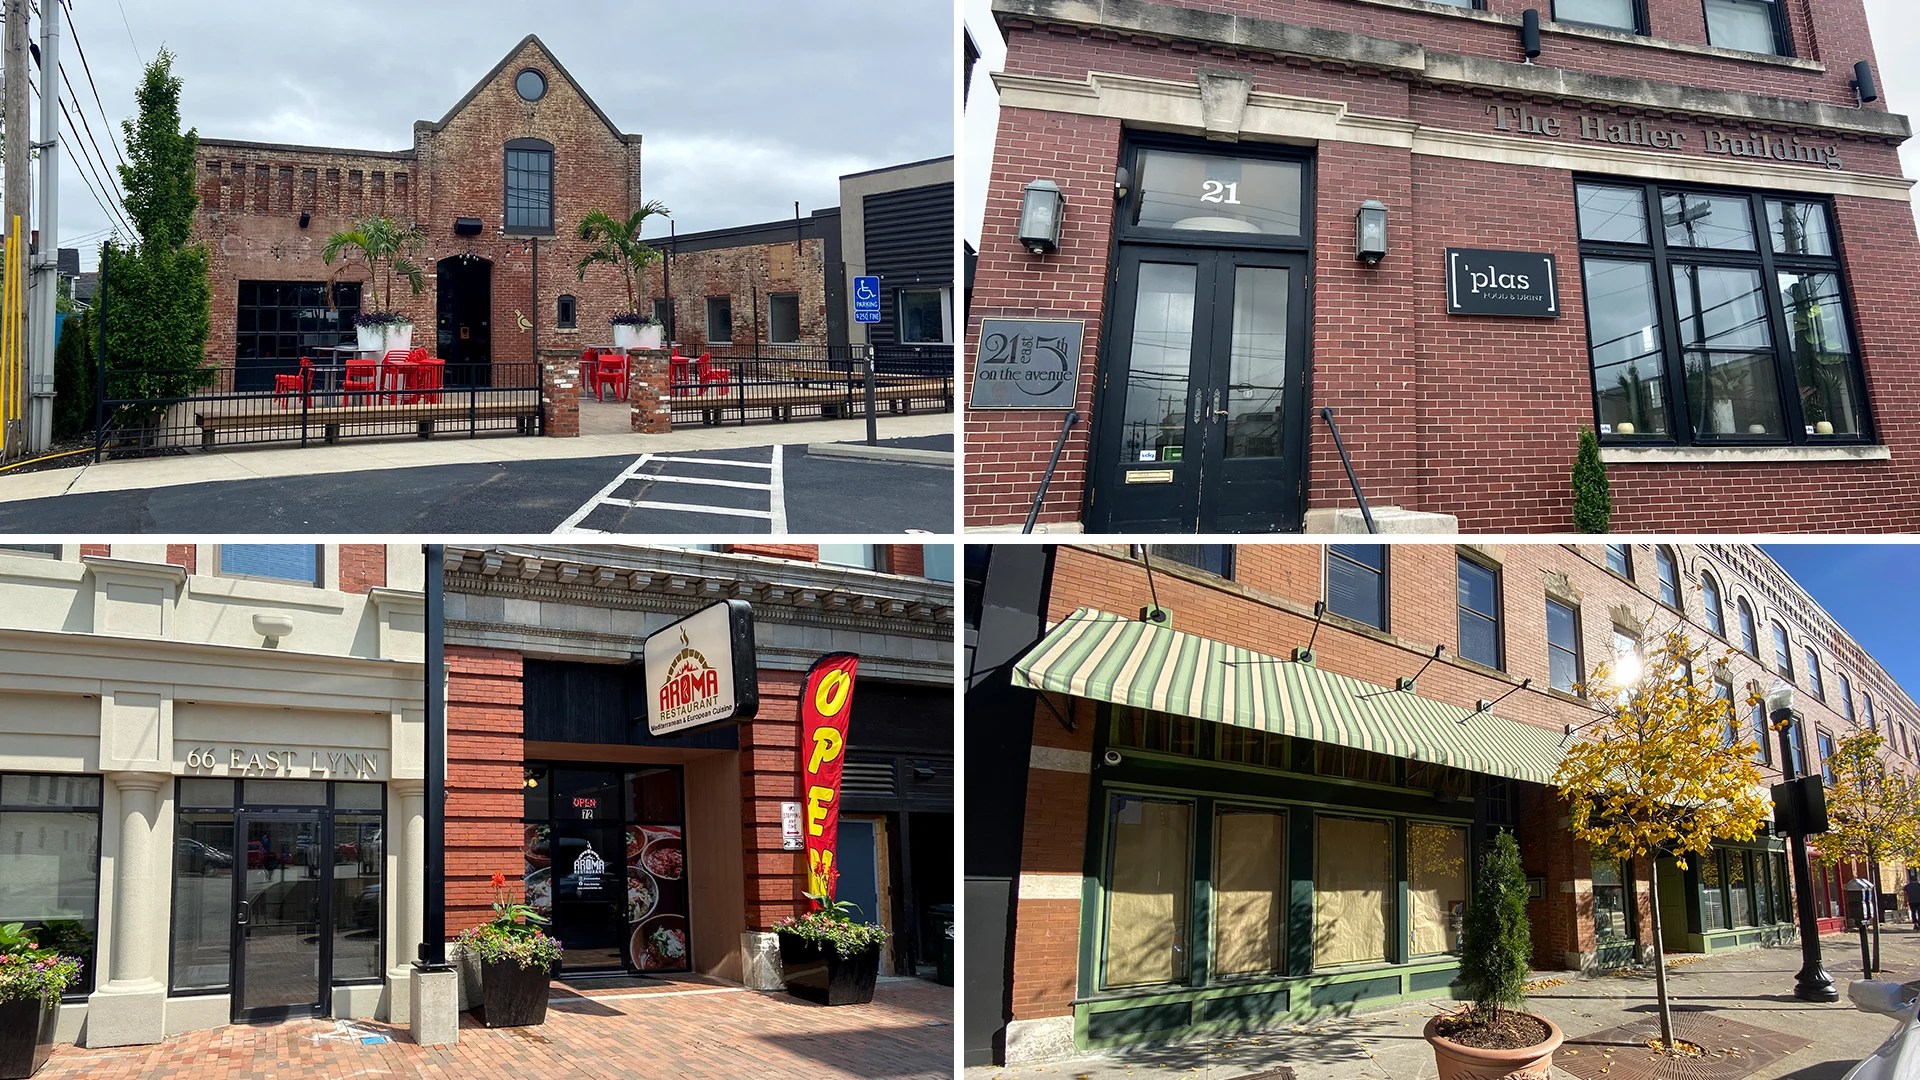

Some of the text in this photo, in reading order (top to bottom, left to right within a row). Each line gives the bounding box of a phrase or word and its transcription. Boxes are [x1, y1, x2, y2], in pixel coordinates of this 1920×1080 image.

[1486, 104, 1843, 171] The Haller Building
[1200, 180, 1241, 205] 21
[1483, 292, 1508, 300] FOOD
[983, 333, 1020, 364] 21
[1020, 336, 1034, 365] east
[979, 367, 1073, 382] on the avenue
[659, 669, 719, 712] AROMA
[651, 719, 682, 731] Mediterranean
[687, 709, 712, 722] European
[712, 704, 733, 716] Cuisine
[660, 695, 719, 721] RESTAURANT
[187, 747, 378, 774] 66 EAST LYNN
[807, 669, 851, 897] OPEN
[573, 798, 596, 807] OPEN
[582, 809, 593, 819] 72
[573, 859, 605, 871] AROMA
